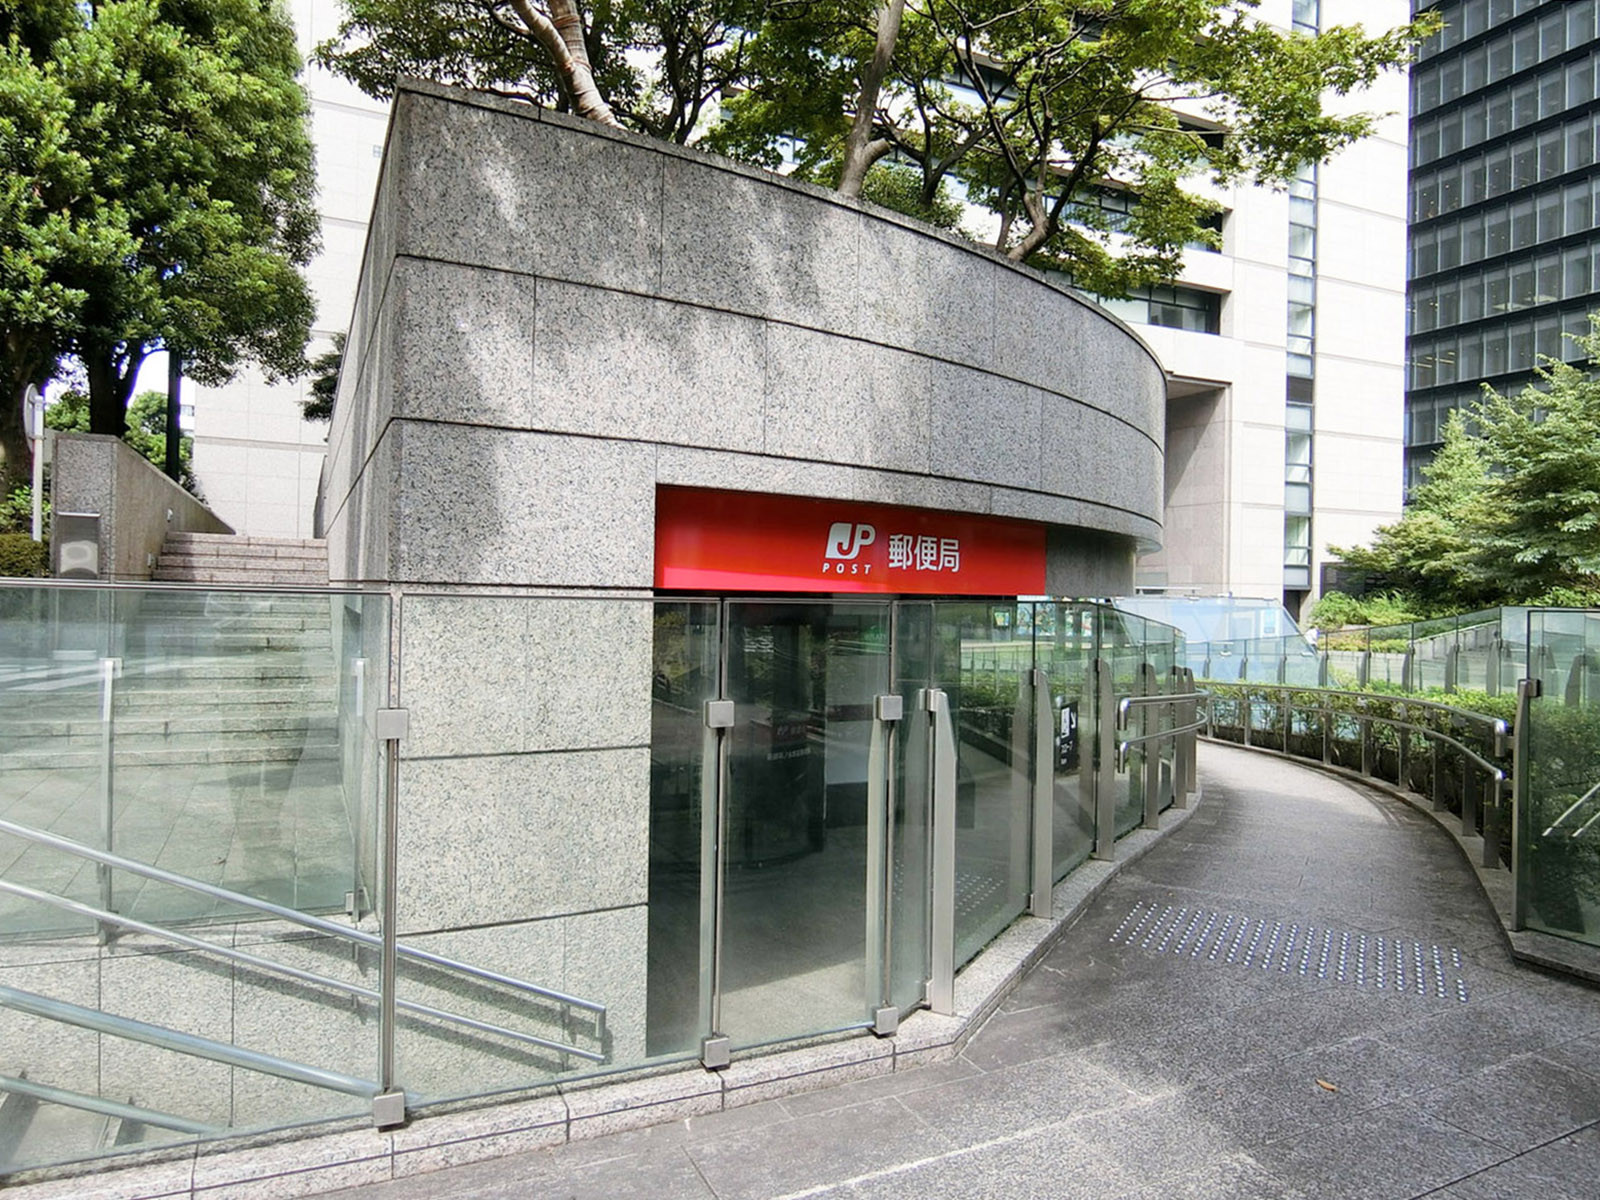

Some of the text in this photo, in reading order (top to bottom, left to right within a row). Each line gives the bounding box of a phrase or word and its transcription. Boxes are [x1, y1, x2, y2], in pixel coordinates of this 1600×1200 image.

[825, 522, 876, 560] JP
[888, 534, 960, 573] 郵便局
[822, 562, 871, 574] POST
